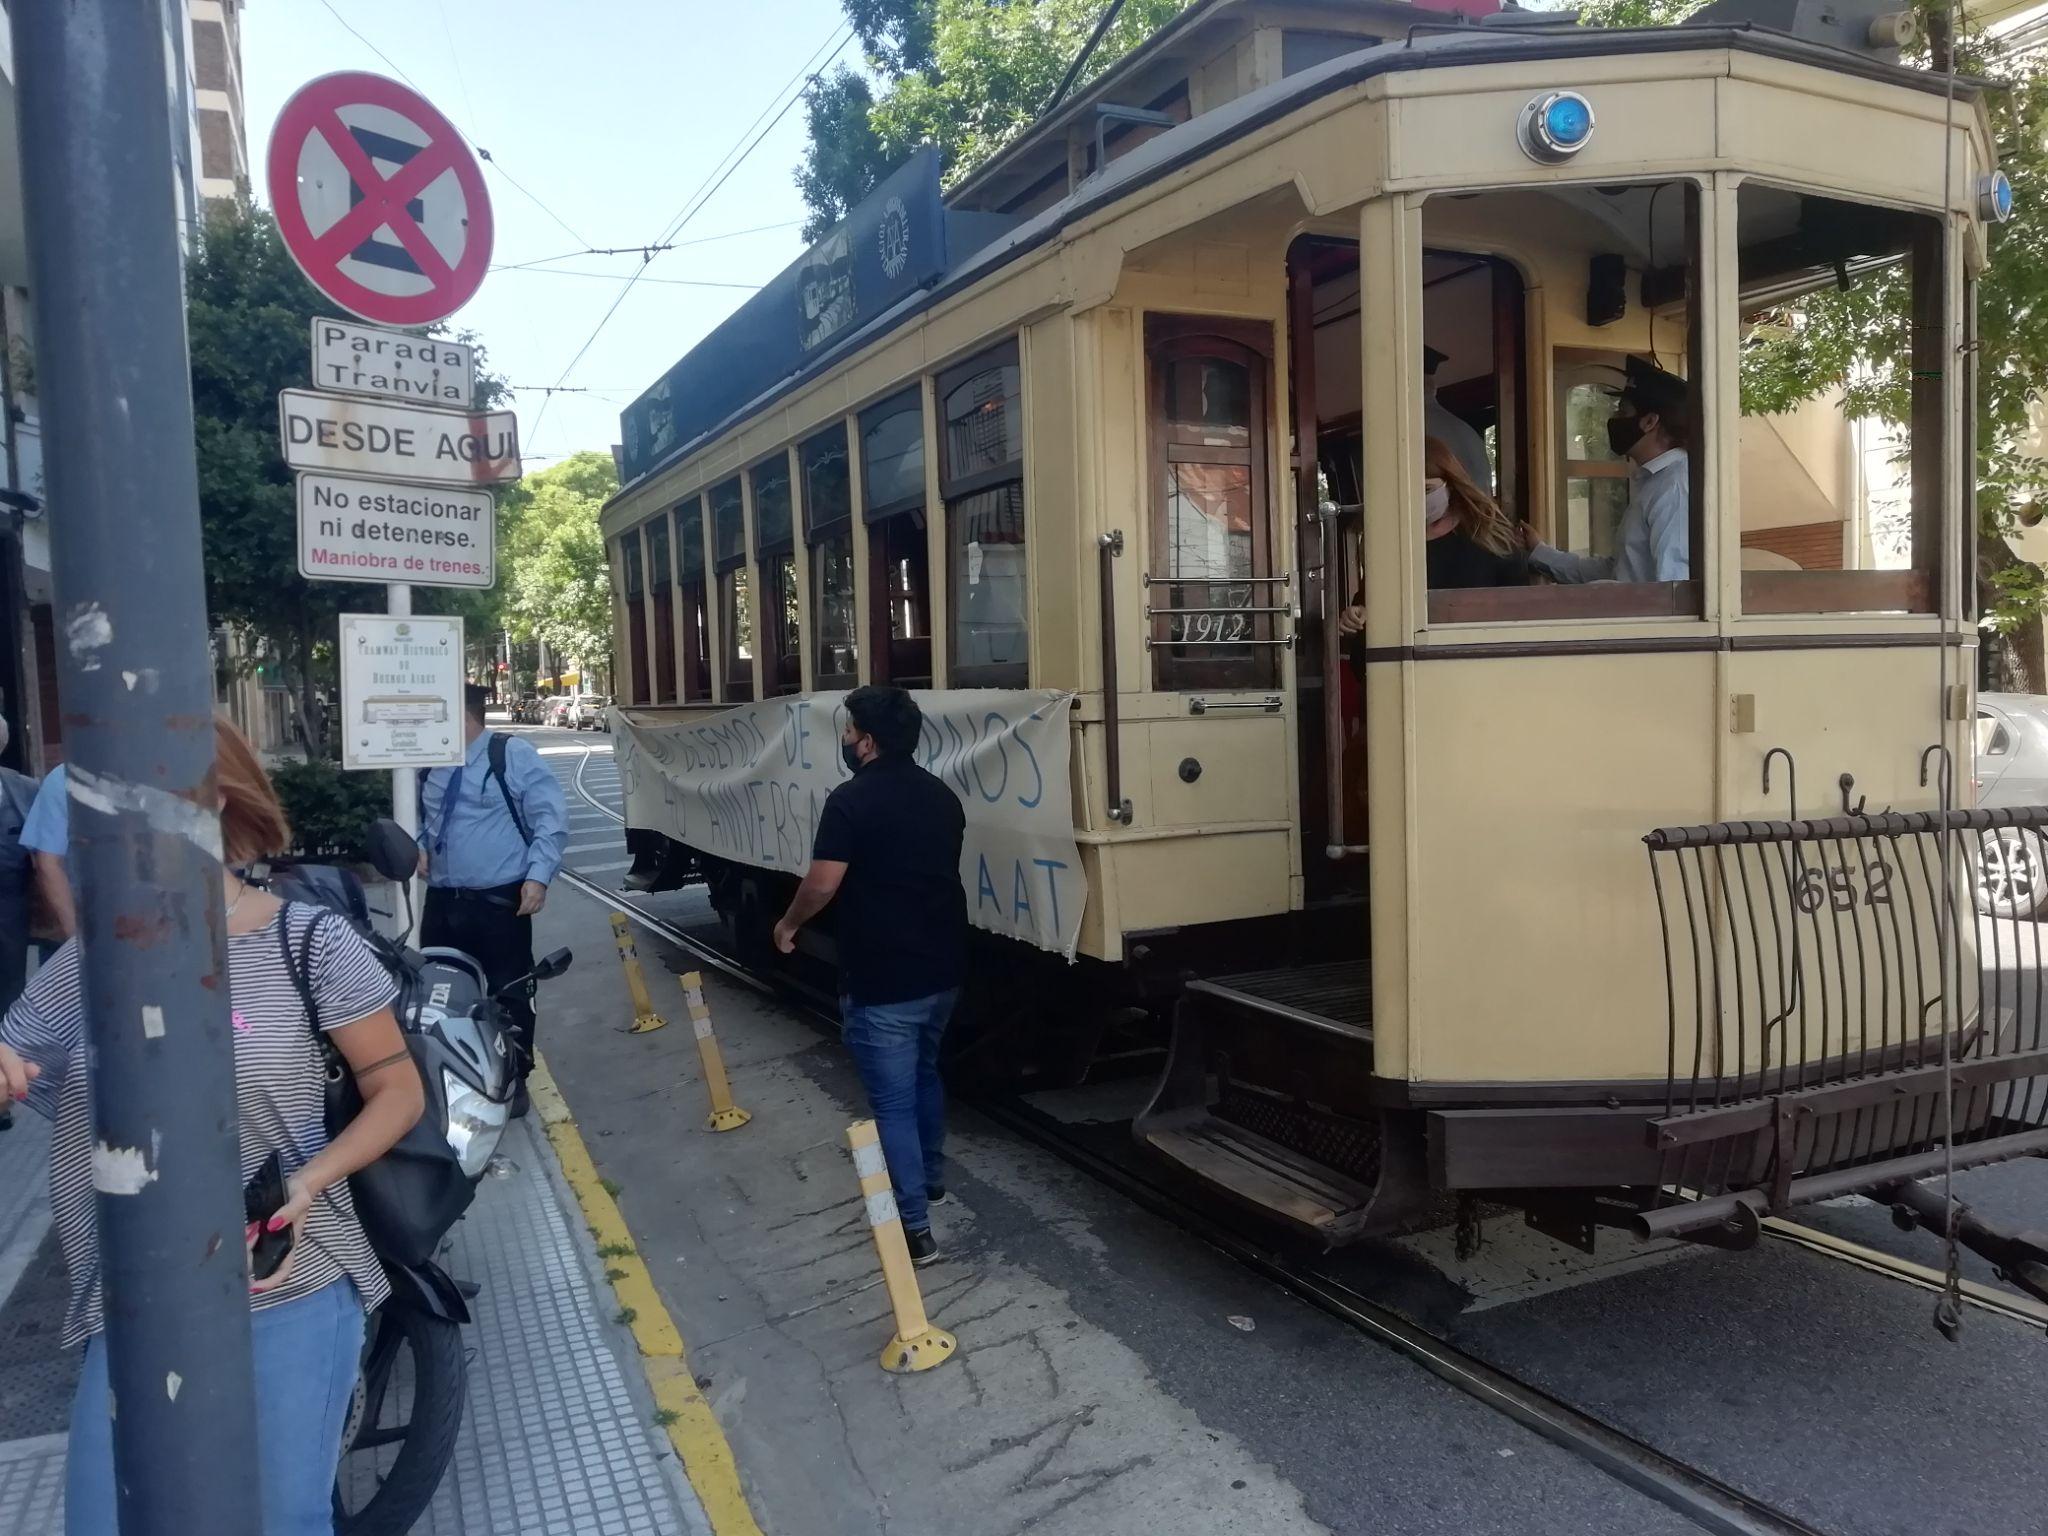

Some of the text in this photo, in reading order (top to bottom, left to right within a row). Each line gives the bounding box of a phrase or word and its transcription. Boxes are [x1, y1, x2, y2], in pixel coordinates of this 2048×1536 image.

[324, 326, 462, 367] Parada
[287, 414, 514, 463] DESDE AQUI
[313, 486, 482, 522] No estacionar
[319, 518, 476, 548] ni detenerse.
[311, 548, 486, 575] Maniobra de trenes.
[1180, 613, 1244, 642] 1912
[784, 702, 812, 770] DE
[977, 852, 1068, 939] AAT
[1795, 860, 1893, 914] 652
